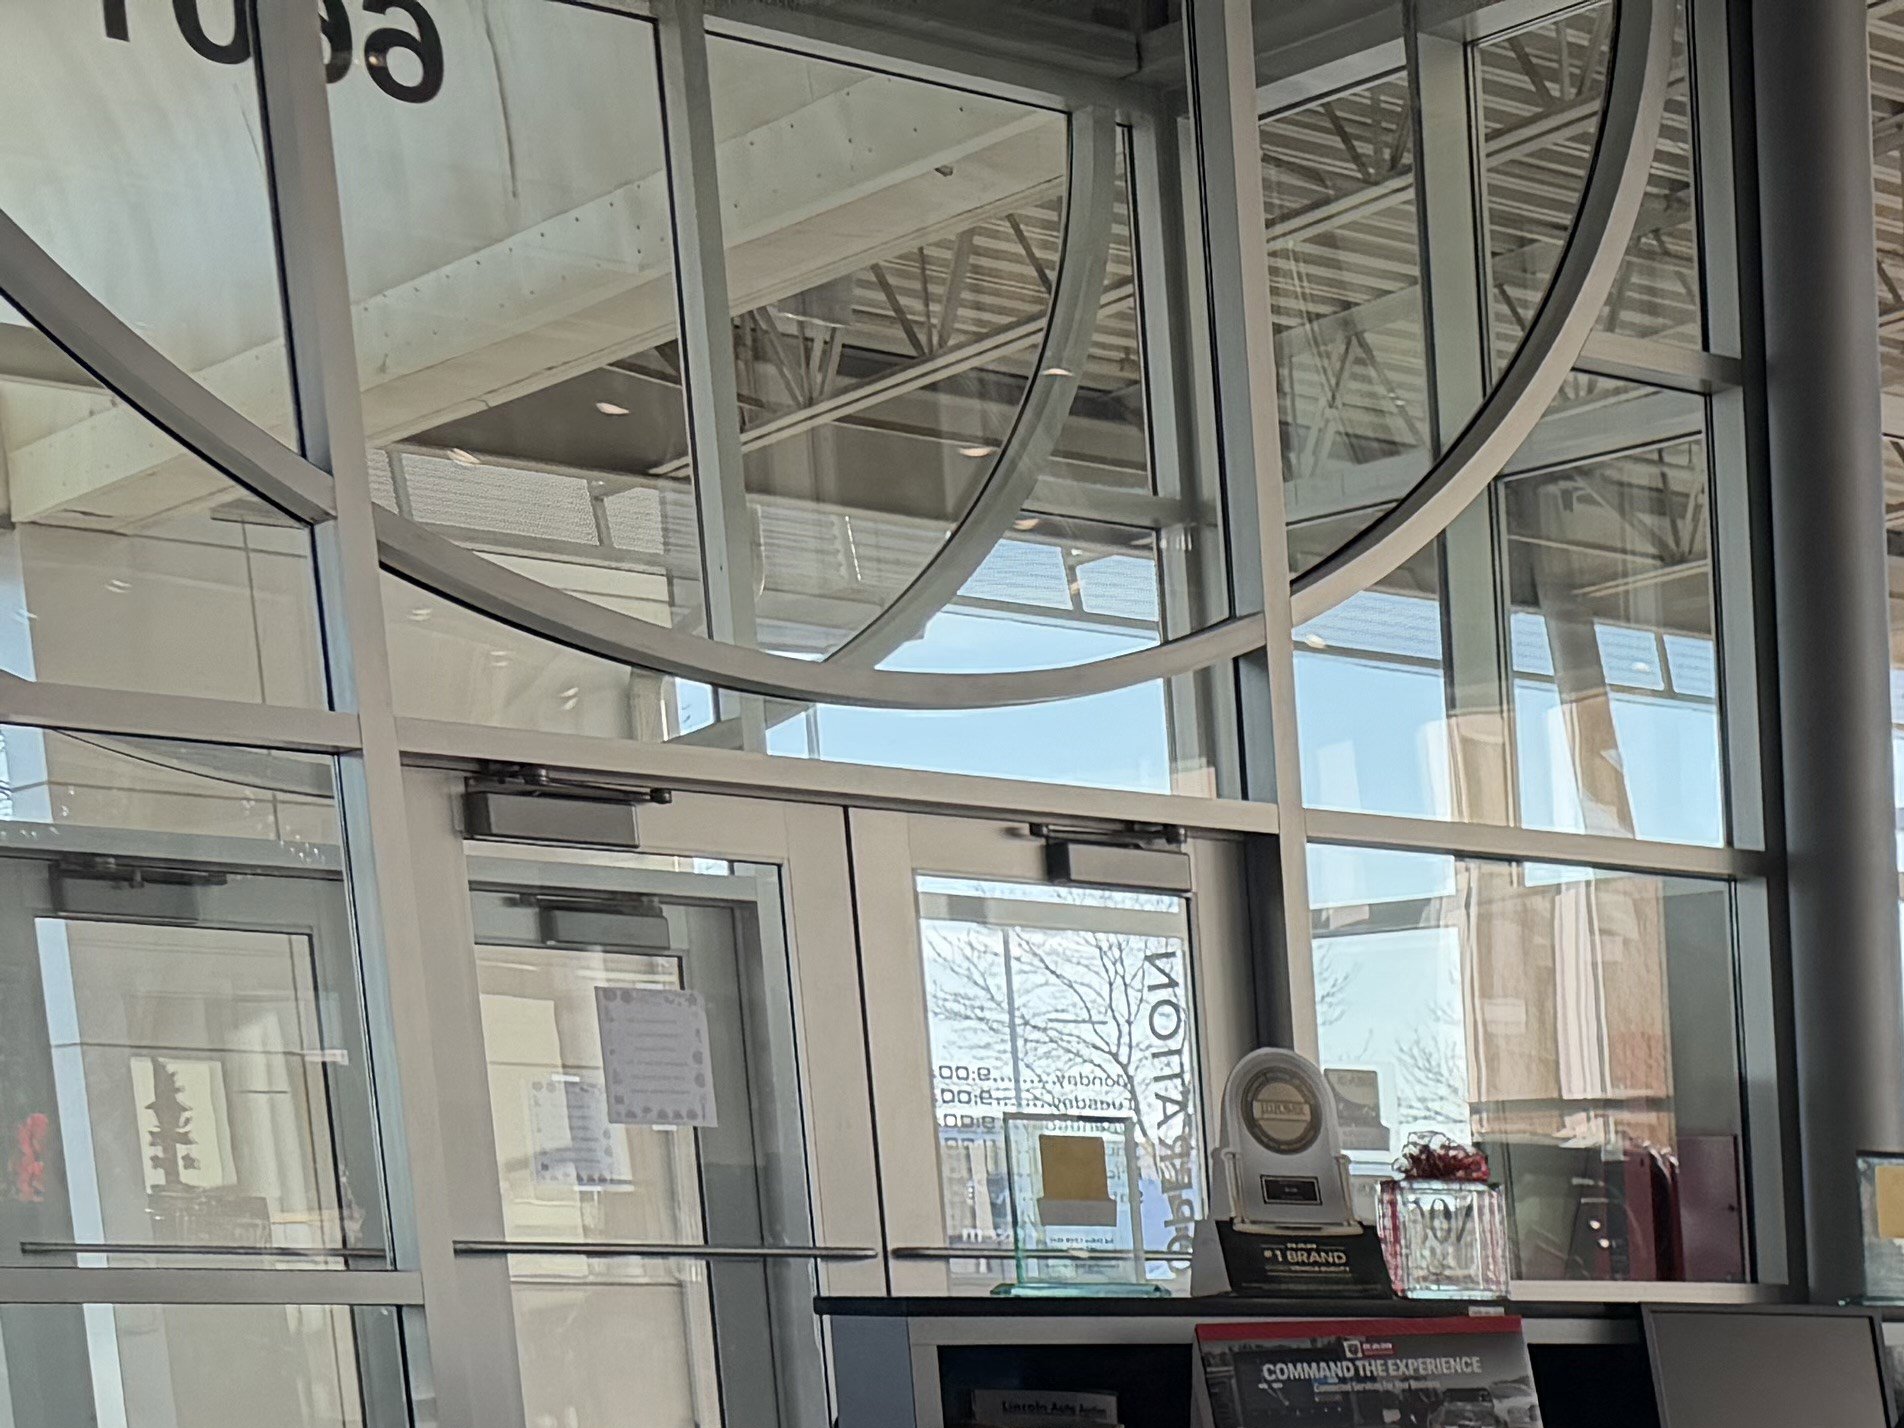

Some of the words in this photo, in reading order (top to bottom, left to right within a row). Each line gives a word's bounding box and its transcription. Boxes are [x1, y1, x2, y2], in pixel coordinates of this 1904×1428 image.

[1286, 1250, 1347, 1264] BRAND
[1262, 1359, 1356, 1381] COMMAND
[1357, 1358, 1388, 1377] THE
[1389, 1356, 1482, 1376] EXPERIENCE
